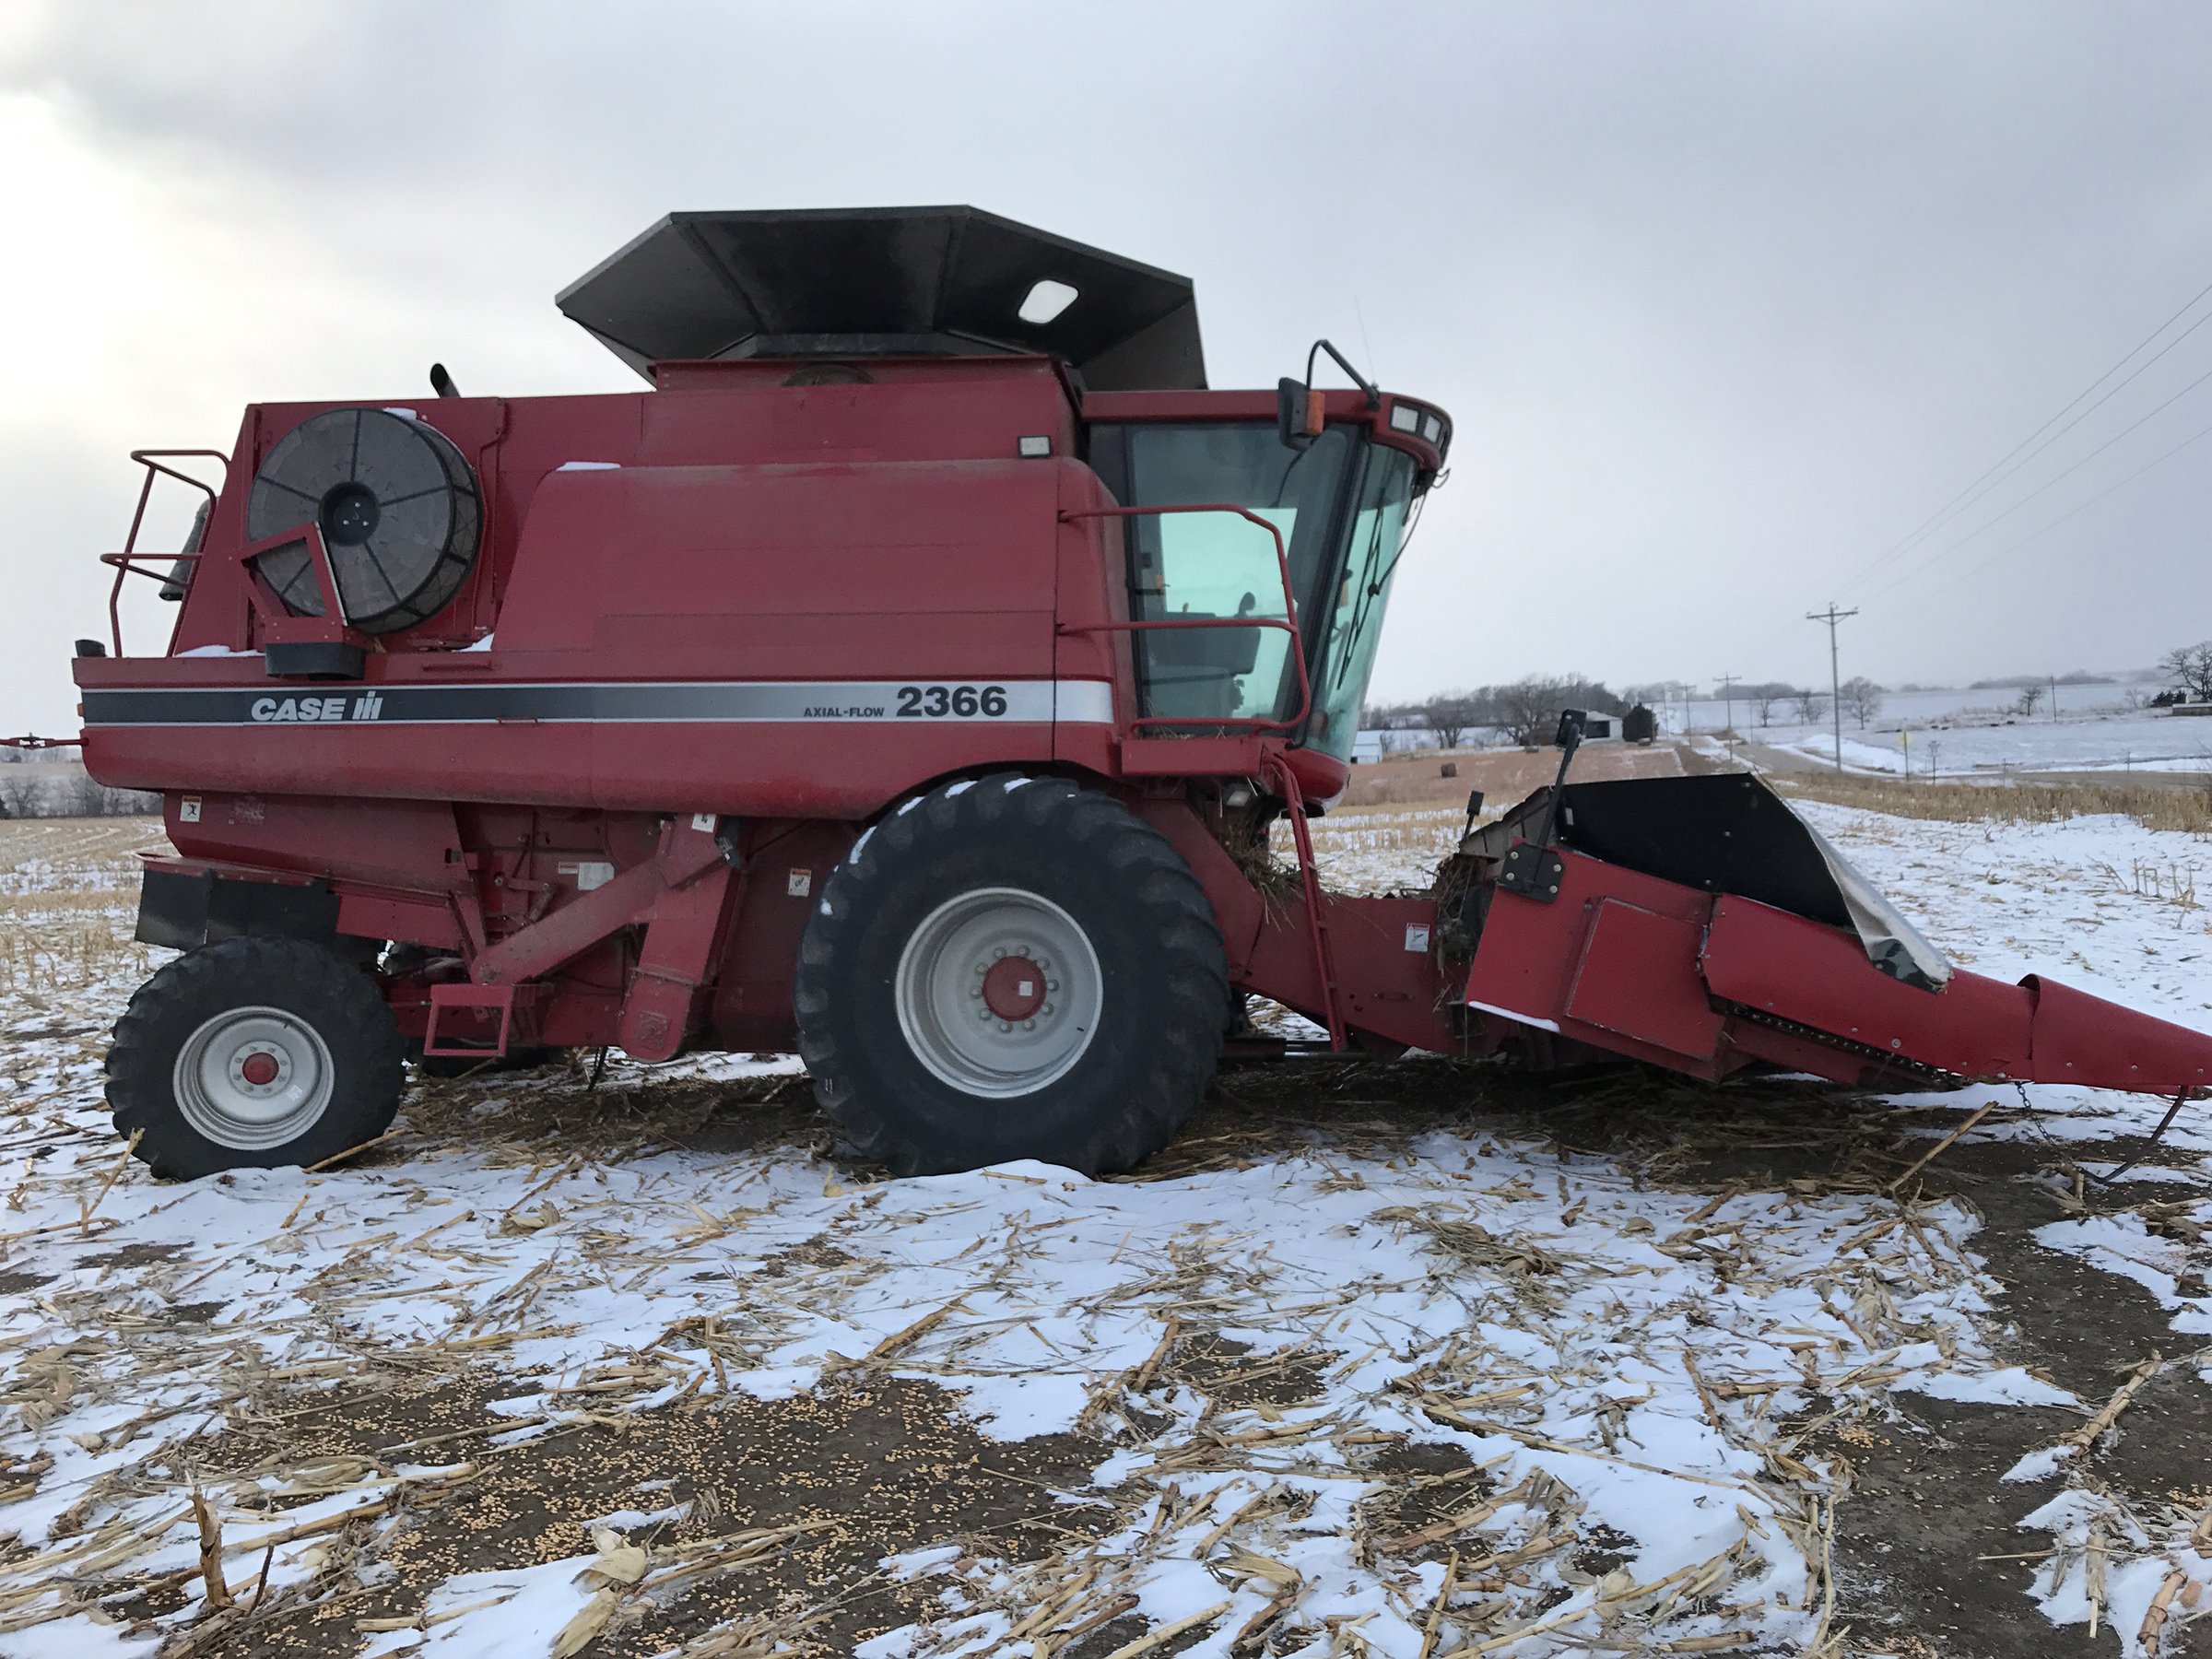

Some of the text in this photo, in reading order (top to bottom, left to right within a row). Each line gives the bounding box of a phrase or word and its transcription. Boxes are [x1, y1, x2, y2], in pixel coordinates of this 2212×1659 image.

[251, 697, 347, 721] CASE
[804, 686, 1007, 717] AXIAL-FLOW 2366
